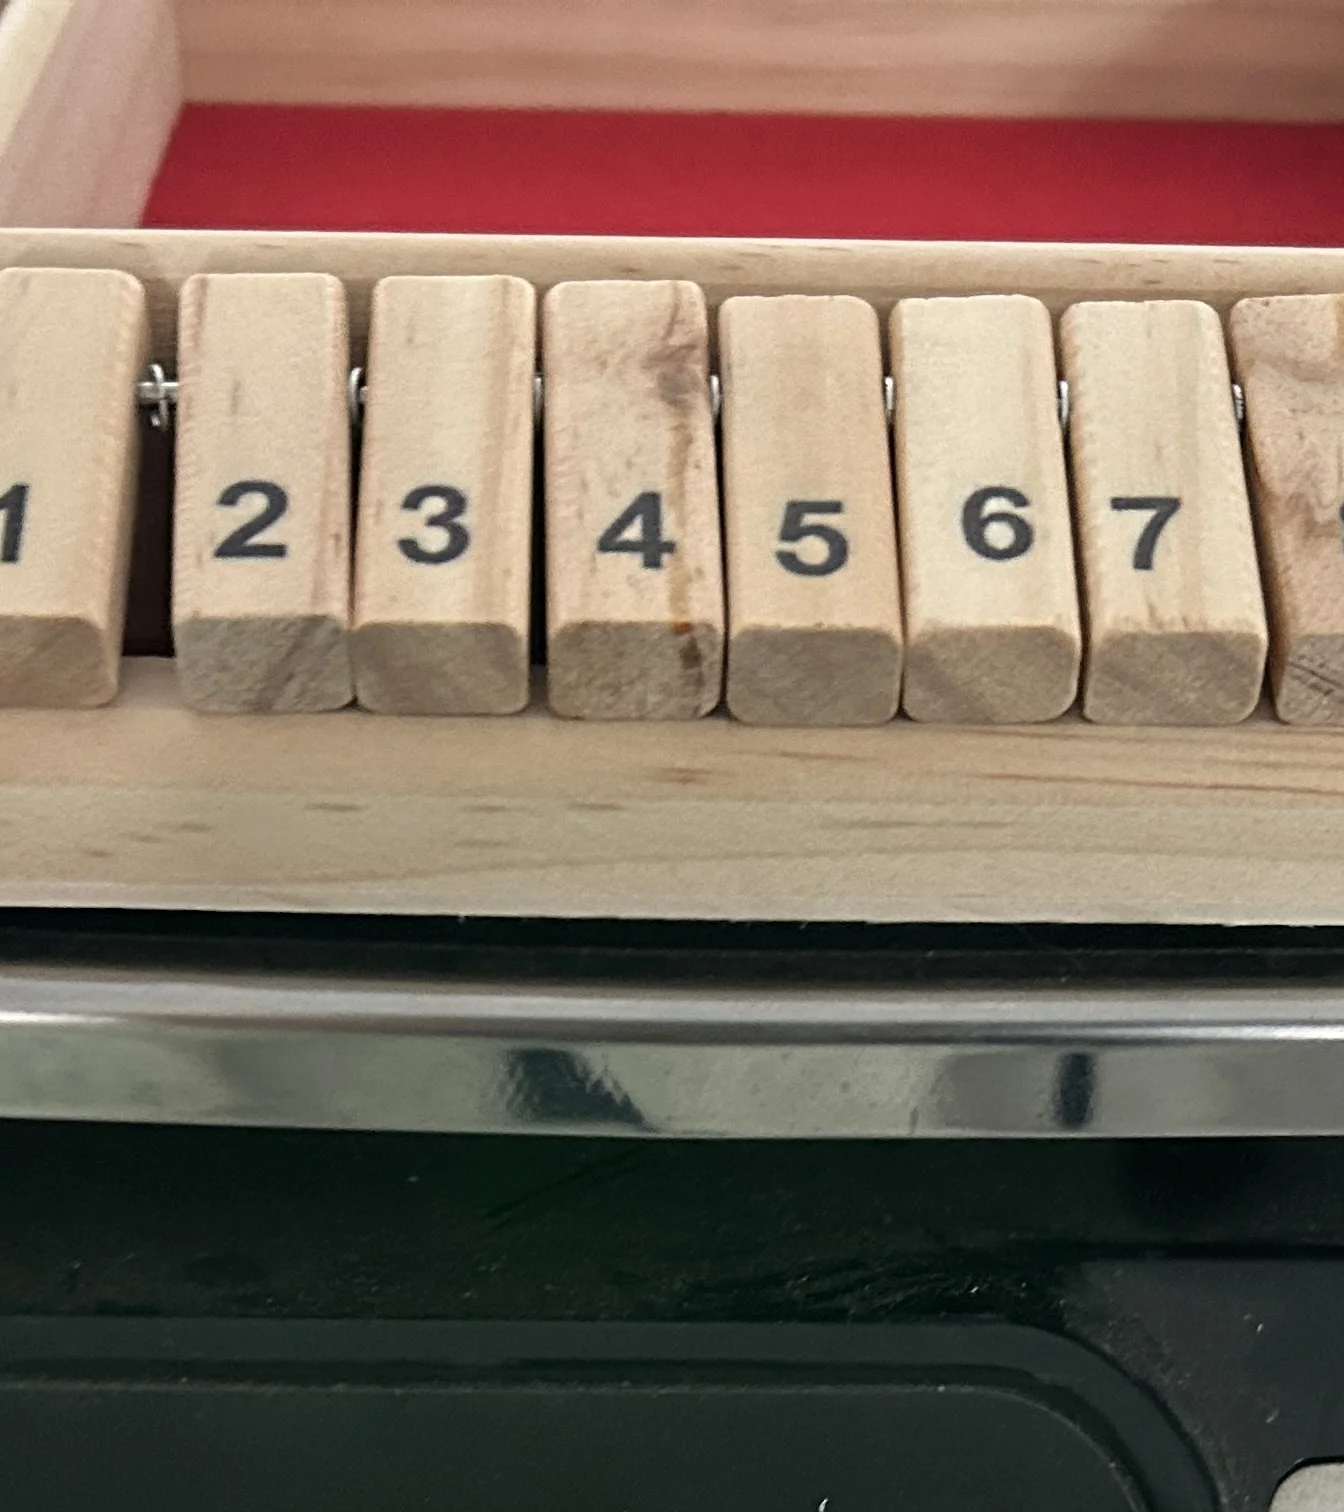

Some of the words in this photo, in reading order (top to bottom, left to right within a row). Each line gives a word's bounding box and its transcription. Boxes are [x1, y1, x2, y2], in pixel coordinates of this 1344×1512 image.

[213, 480, 290, 558] 2
[397, 484, 471, 565] 3
[596, 491, 677, 569] 4
[775, 500, 849, 577] 5
[961, 485, 1034, 561] 6
[1110, 497, 1183, 571] 7
